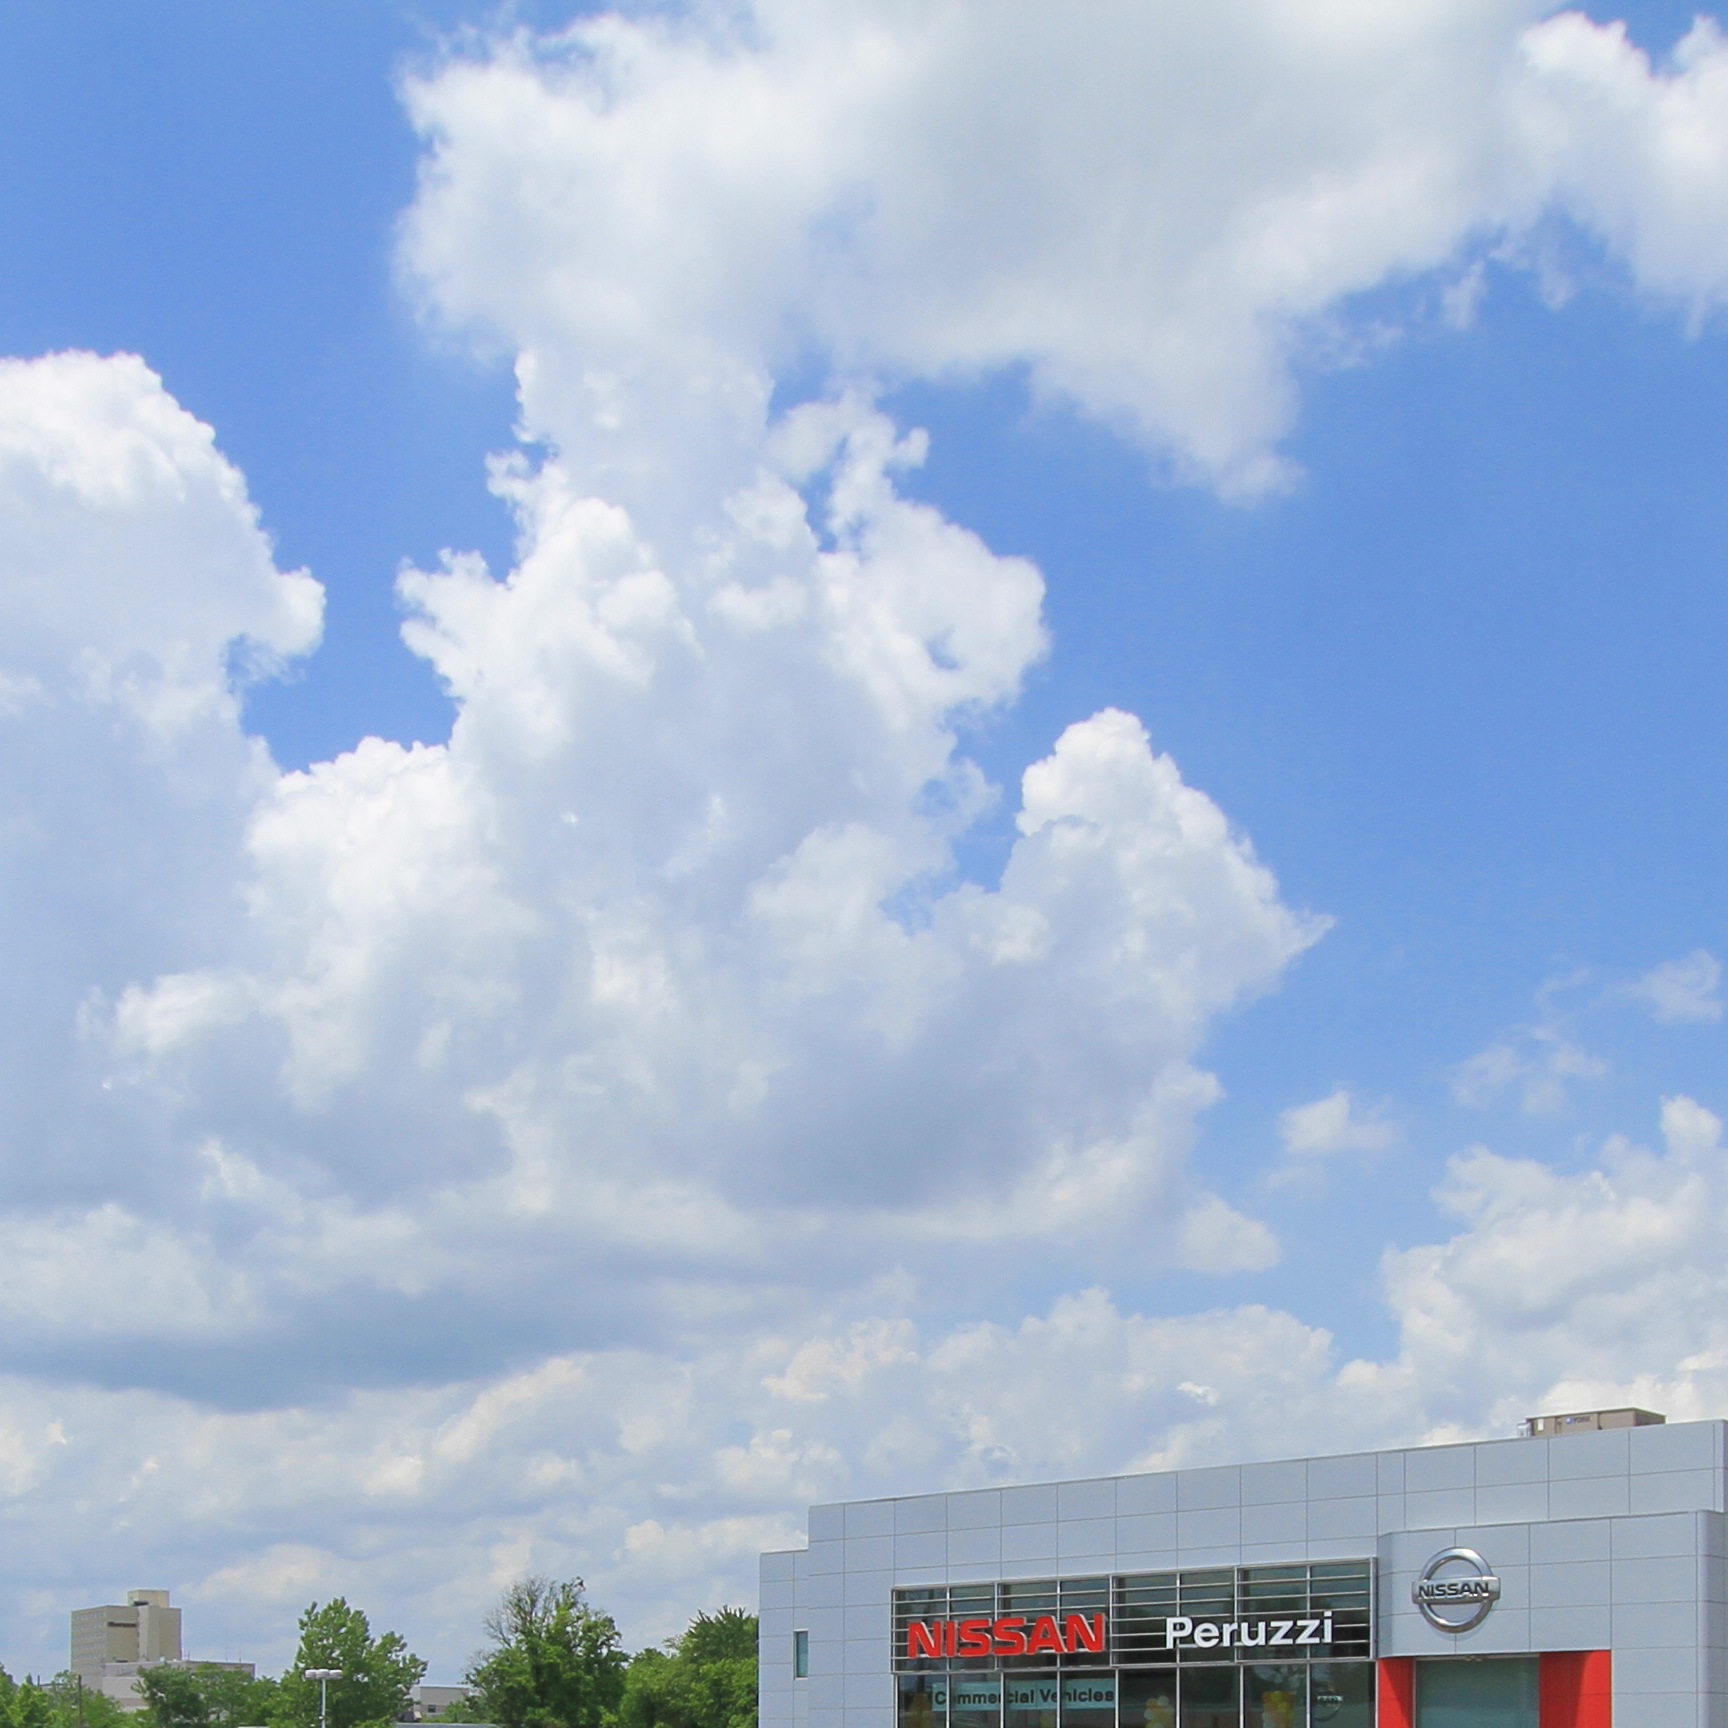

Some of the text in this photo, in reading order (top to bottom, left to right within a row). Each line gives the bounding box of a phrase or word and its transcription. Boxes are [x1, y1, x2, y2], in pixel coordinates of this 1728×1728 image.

[1418, 1582, 1490, 1598] NISSAN
[907, 1610, 1333, 1659] NISSAN Peruzzi
[934, 1687, 1115, 1706] Cmmercial Vehicles
